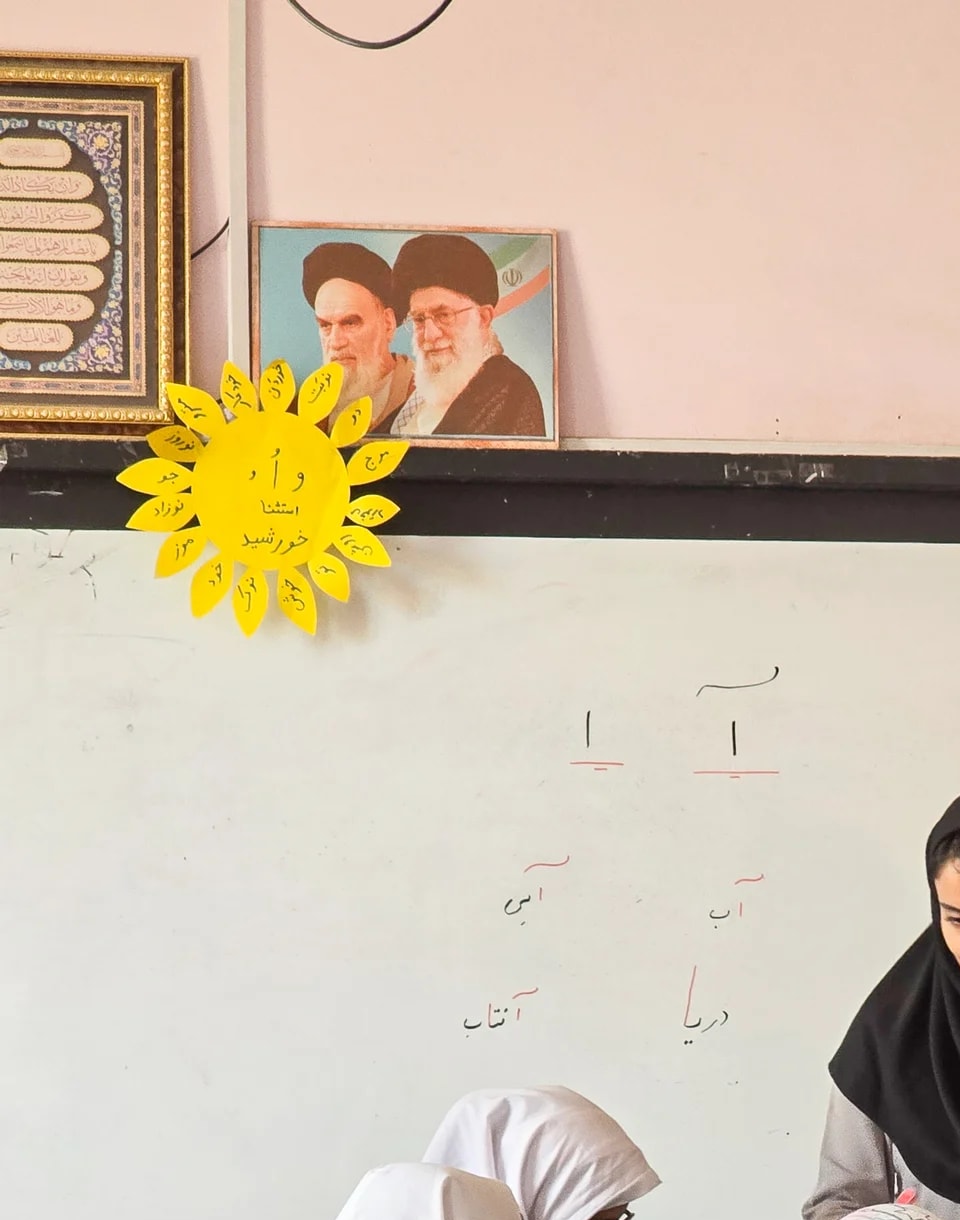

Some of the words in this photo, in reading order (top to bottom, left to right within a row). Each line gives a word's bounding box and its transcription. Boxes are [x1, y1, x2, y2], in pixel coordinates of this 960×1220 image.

[154, 499, 184, 517] نوزاد
[260, 499, 299, 516] استثنا
[175, 538, 194, 561] موز
[241, 528, 309, 555] خورشید
[709, 874, 764, 929] آب
[683, 965, 729, 1045] دریا
